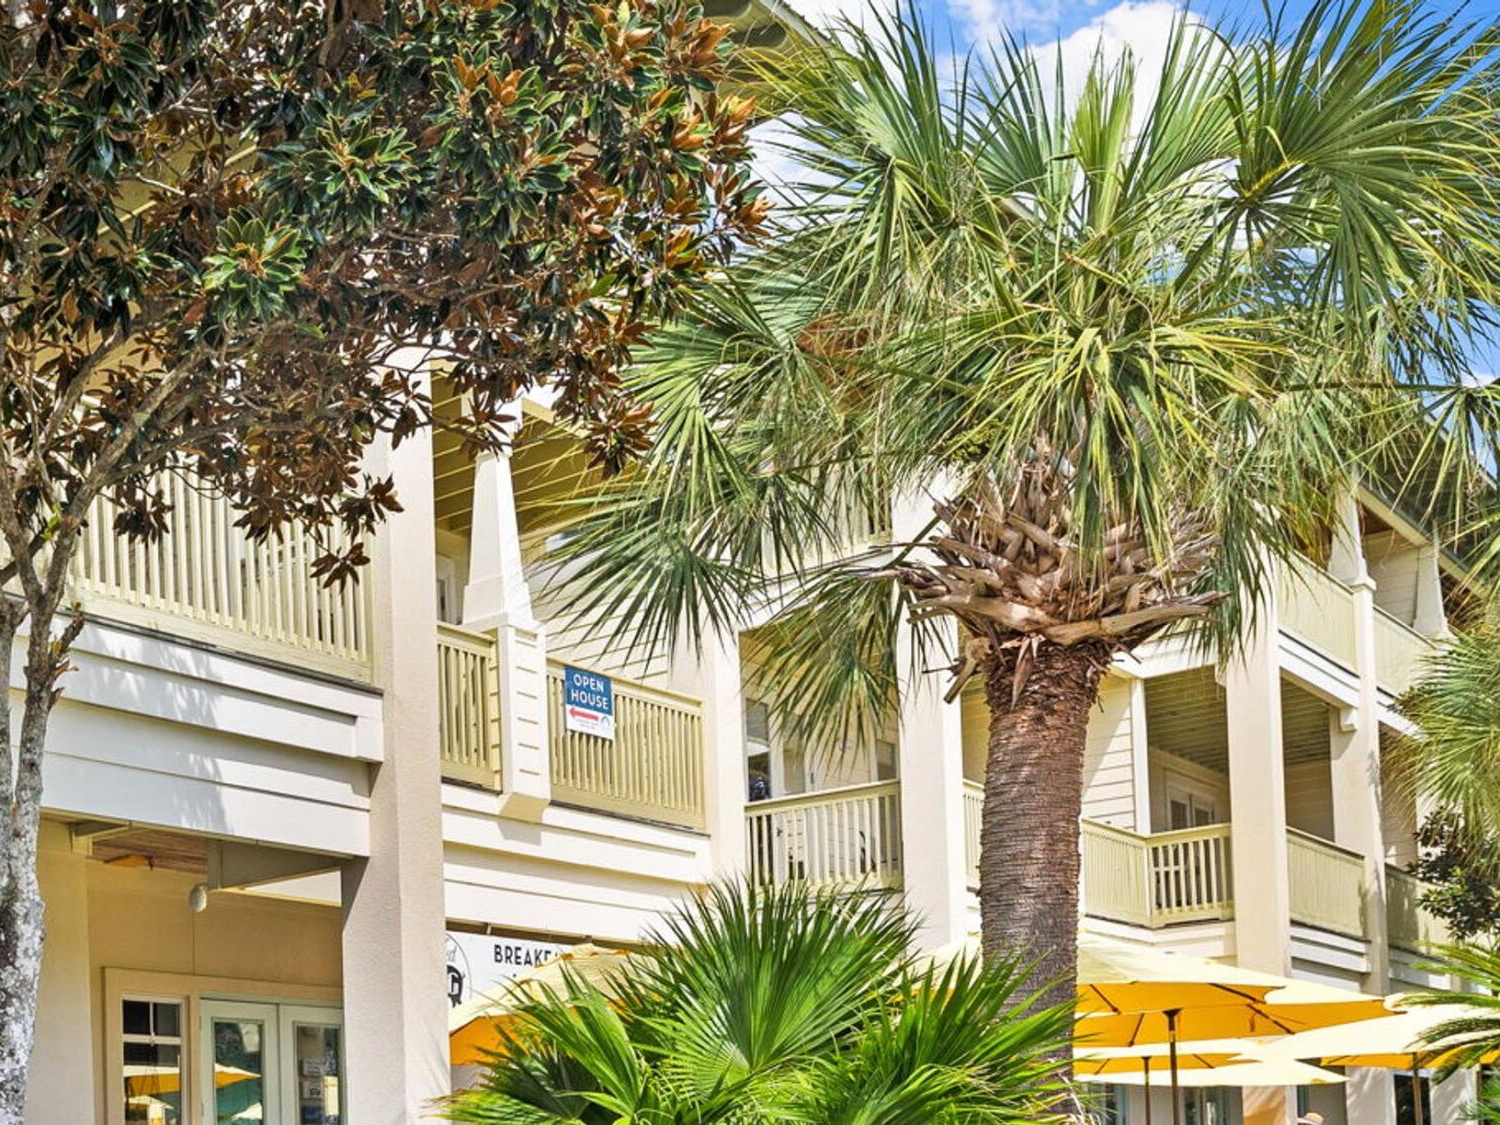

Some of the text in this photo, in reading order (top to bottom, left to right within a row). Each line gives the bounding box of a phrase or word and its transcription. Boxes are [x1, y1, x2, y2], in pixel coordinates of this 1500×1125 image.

[573, 673, 604, 692] OPEN
[571, 689, 609, 710] HOUSE
[494, 944, 558, 966] BREAKF
